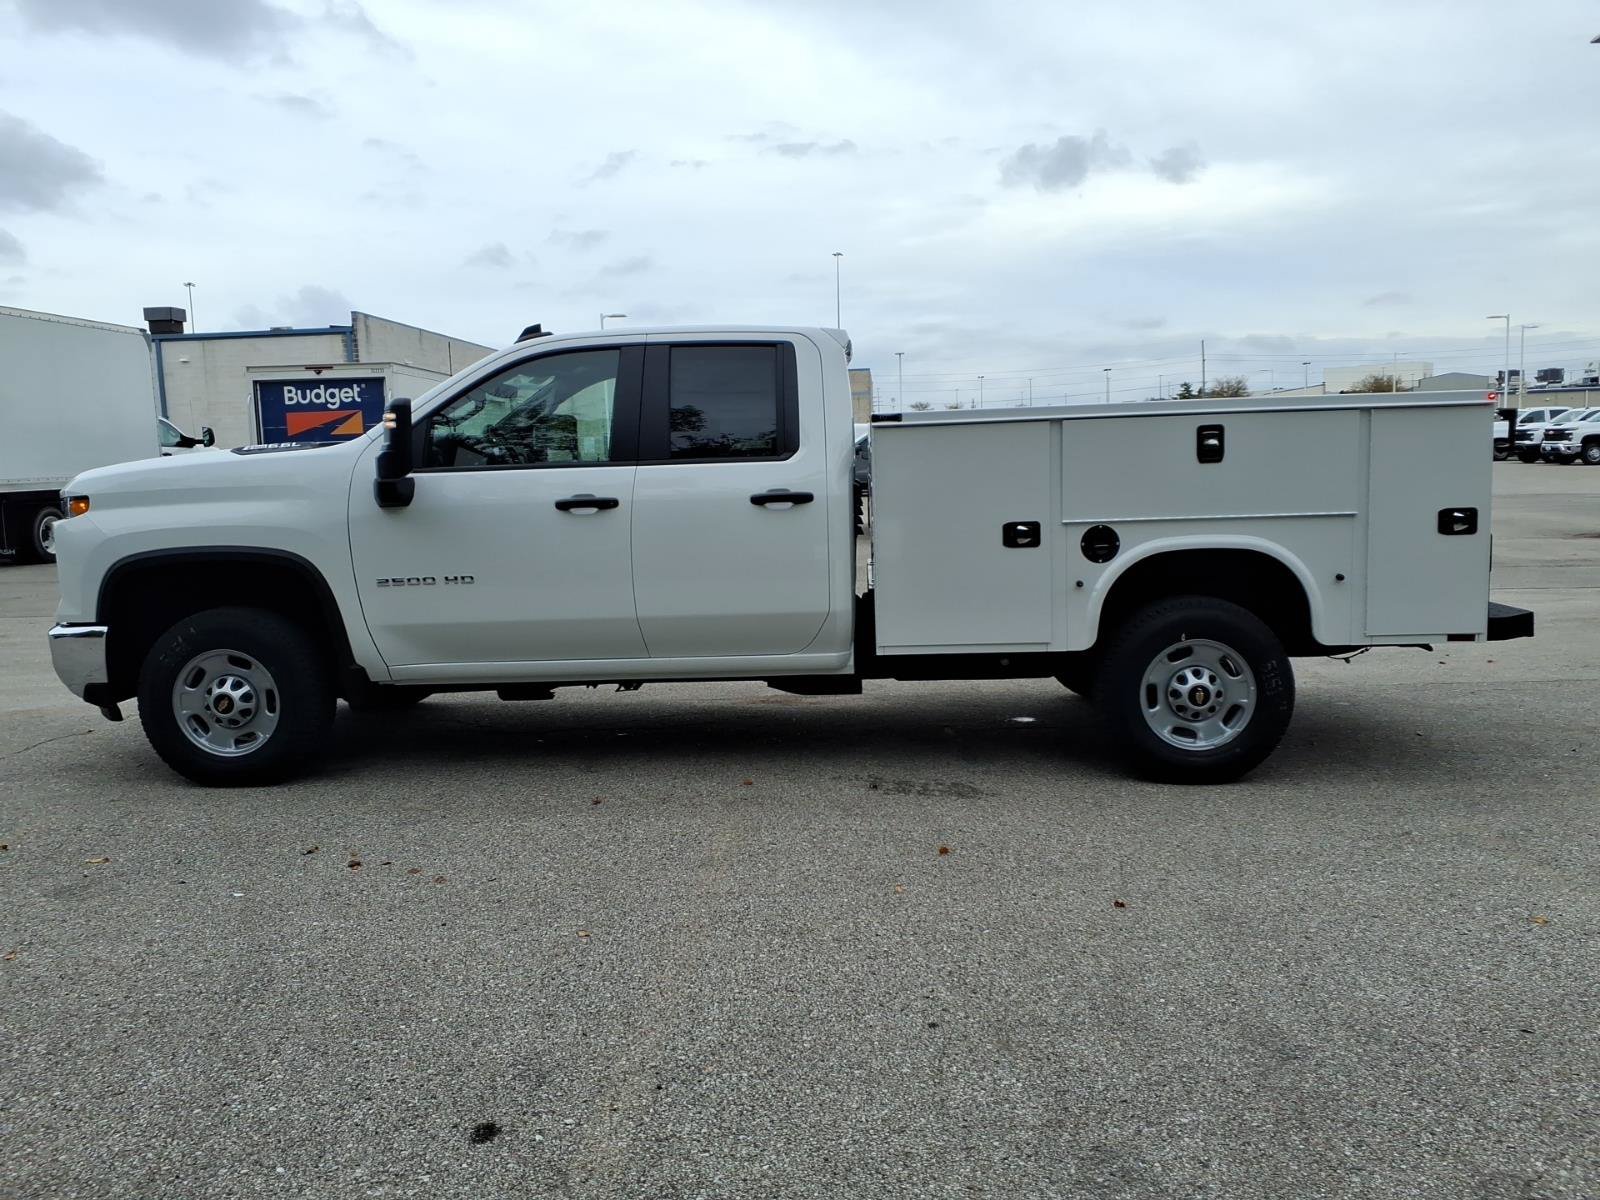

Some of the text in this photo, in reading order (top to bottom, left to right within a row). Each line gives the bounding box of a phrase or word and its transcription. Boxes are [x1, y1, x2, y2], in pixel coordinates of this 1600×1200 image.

[283, 383, 361, 409] Budget
[376, 575, 475, 587] 2500 HD
